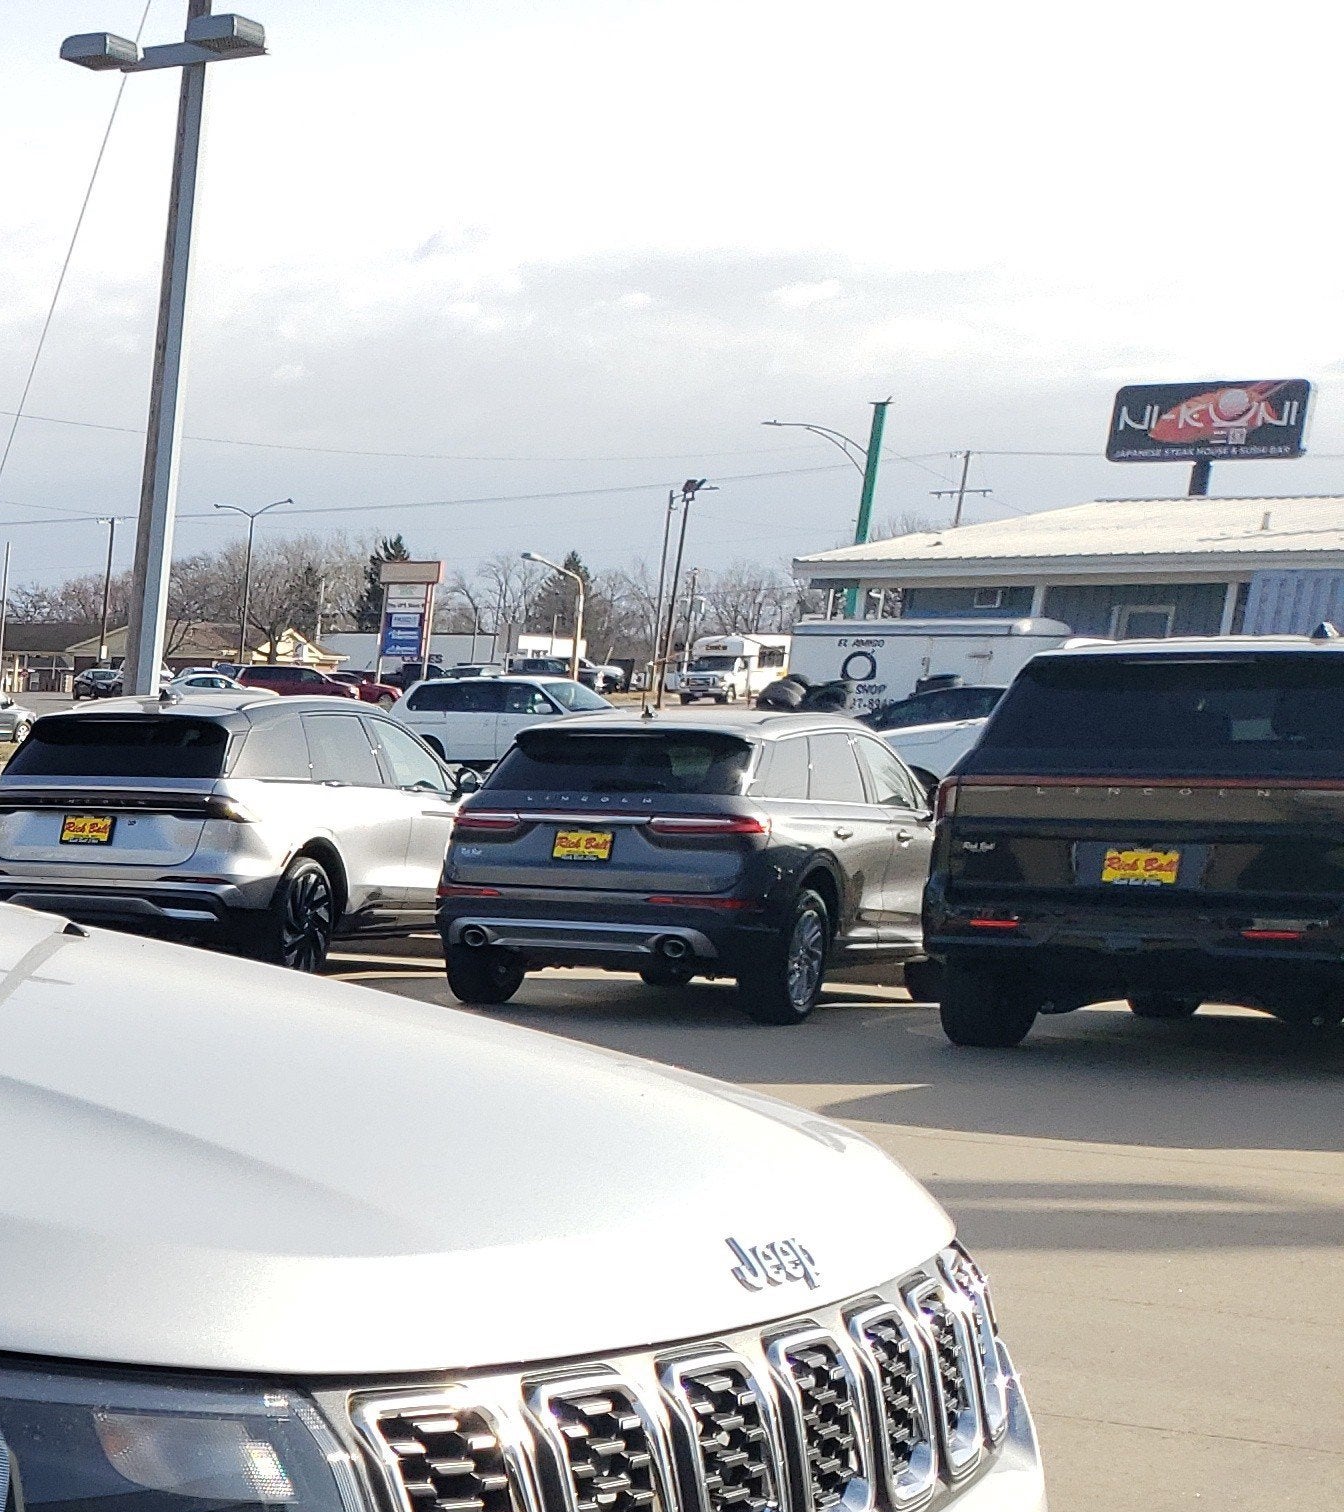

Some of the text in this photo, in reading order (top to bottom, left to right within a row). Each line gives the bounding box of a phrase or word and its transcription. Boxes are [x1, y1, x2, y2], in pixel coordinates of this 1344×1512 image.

[856, 683, 887, 695] SHOP
[1036, 786, 1270, 797] LINCOLN
[65, 821, 110, 834] Rick Ball
[556, 836, 611, 849] Rick Ball
[1107, 856, 1178, 872] Rick Ball
[724, 1236, 820, 1293] Jeep
